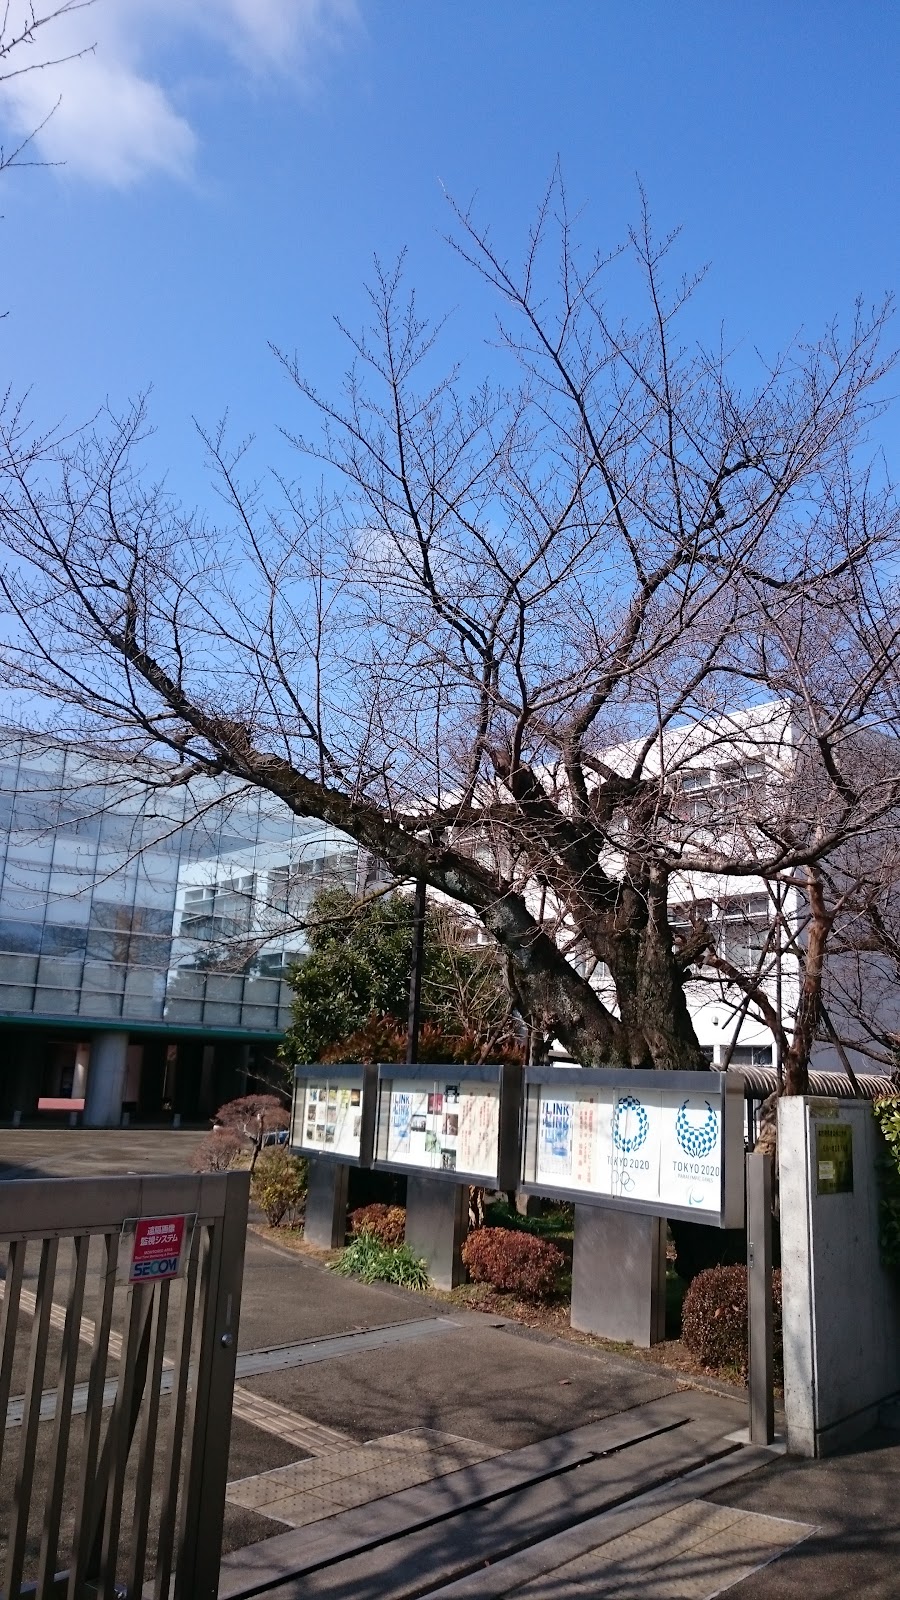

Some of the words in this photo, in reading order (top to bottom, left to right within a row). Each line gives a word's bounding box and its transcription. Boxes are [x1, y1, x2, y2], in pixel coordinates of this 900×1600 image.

[546, 1102, 570, 1116] LINK
[607, 1156, 628, 1168] TOKYO
[629, 1159, 650, 1170] 2020
[673, 1161, 700, 1174] TOKYO
[701, 1164, 720, 1177] 2020
[140, 1234, 178, 1246] 監視システム
[134, 1258, 177, 1276] SECOM
